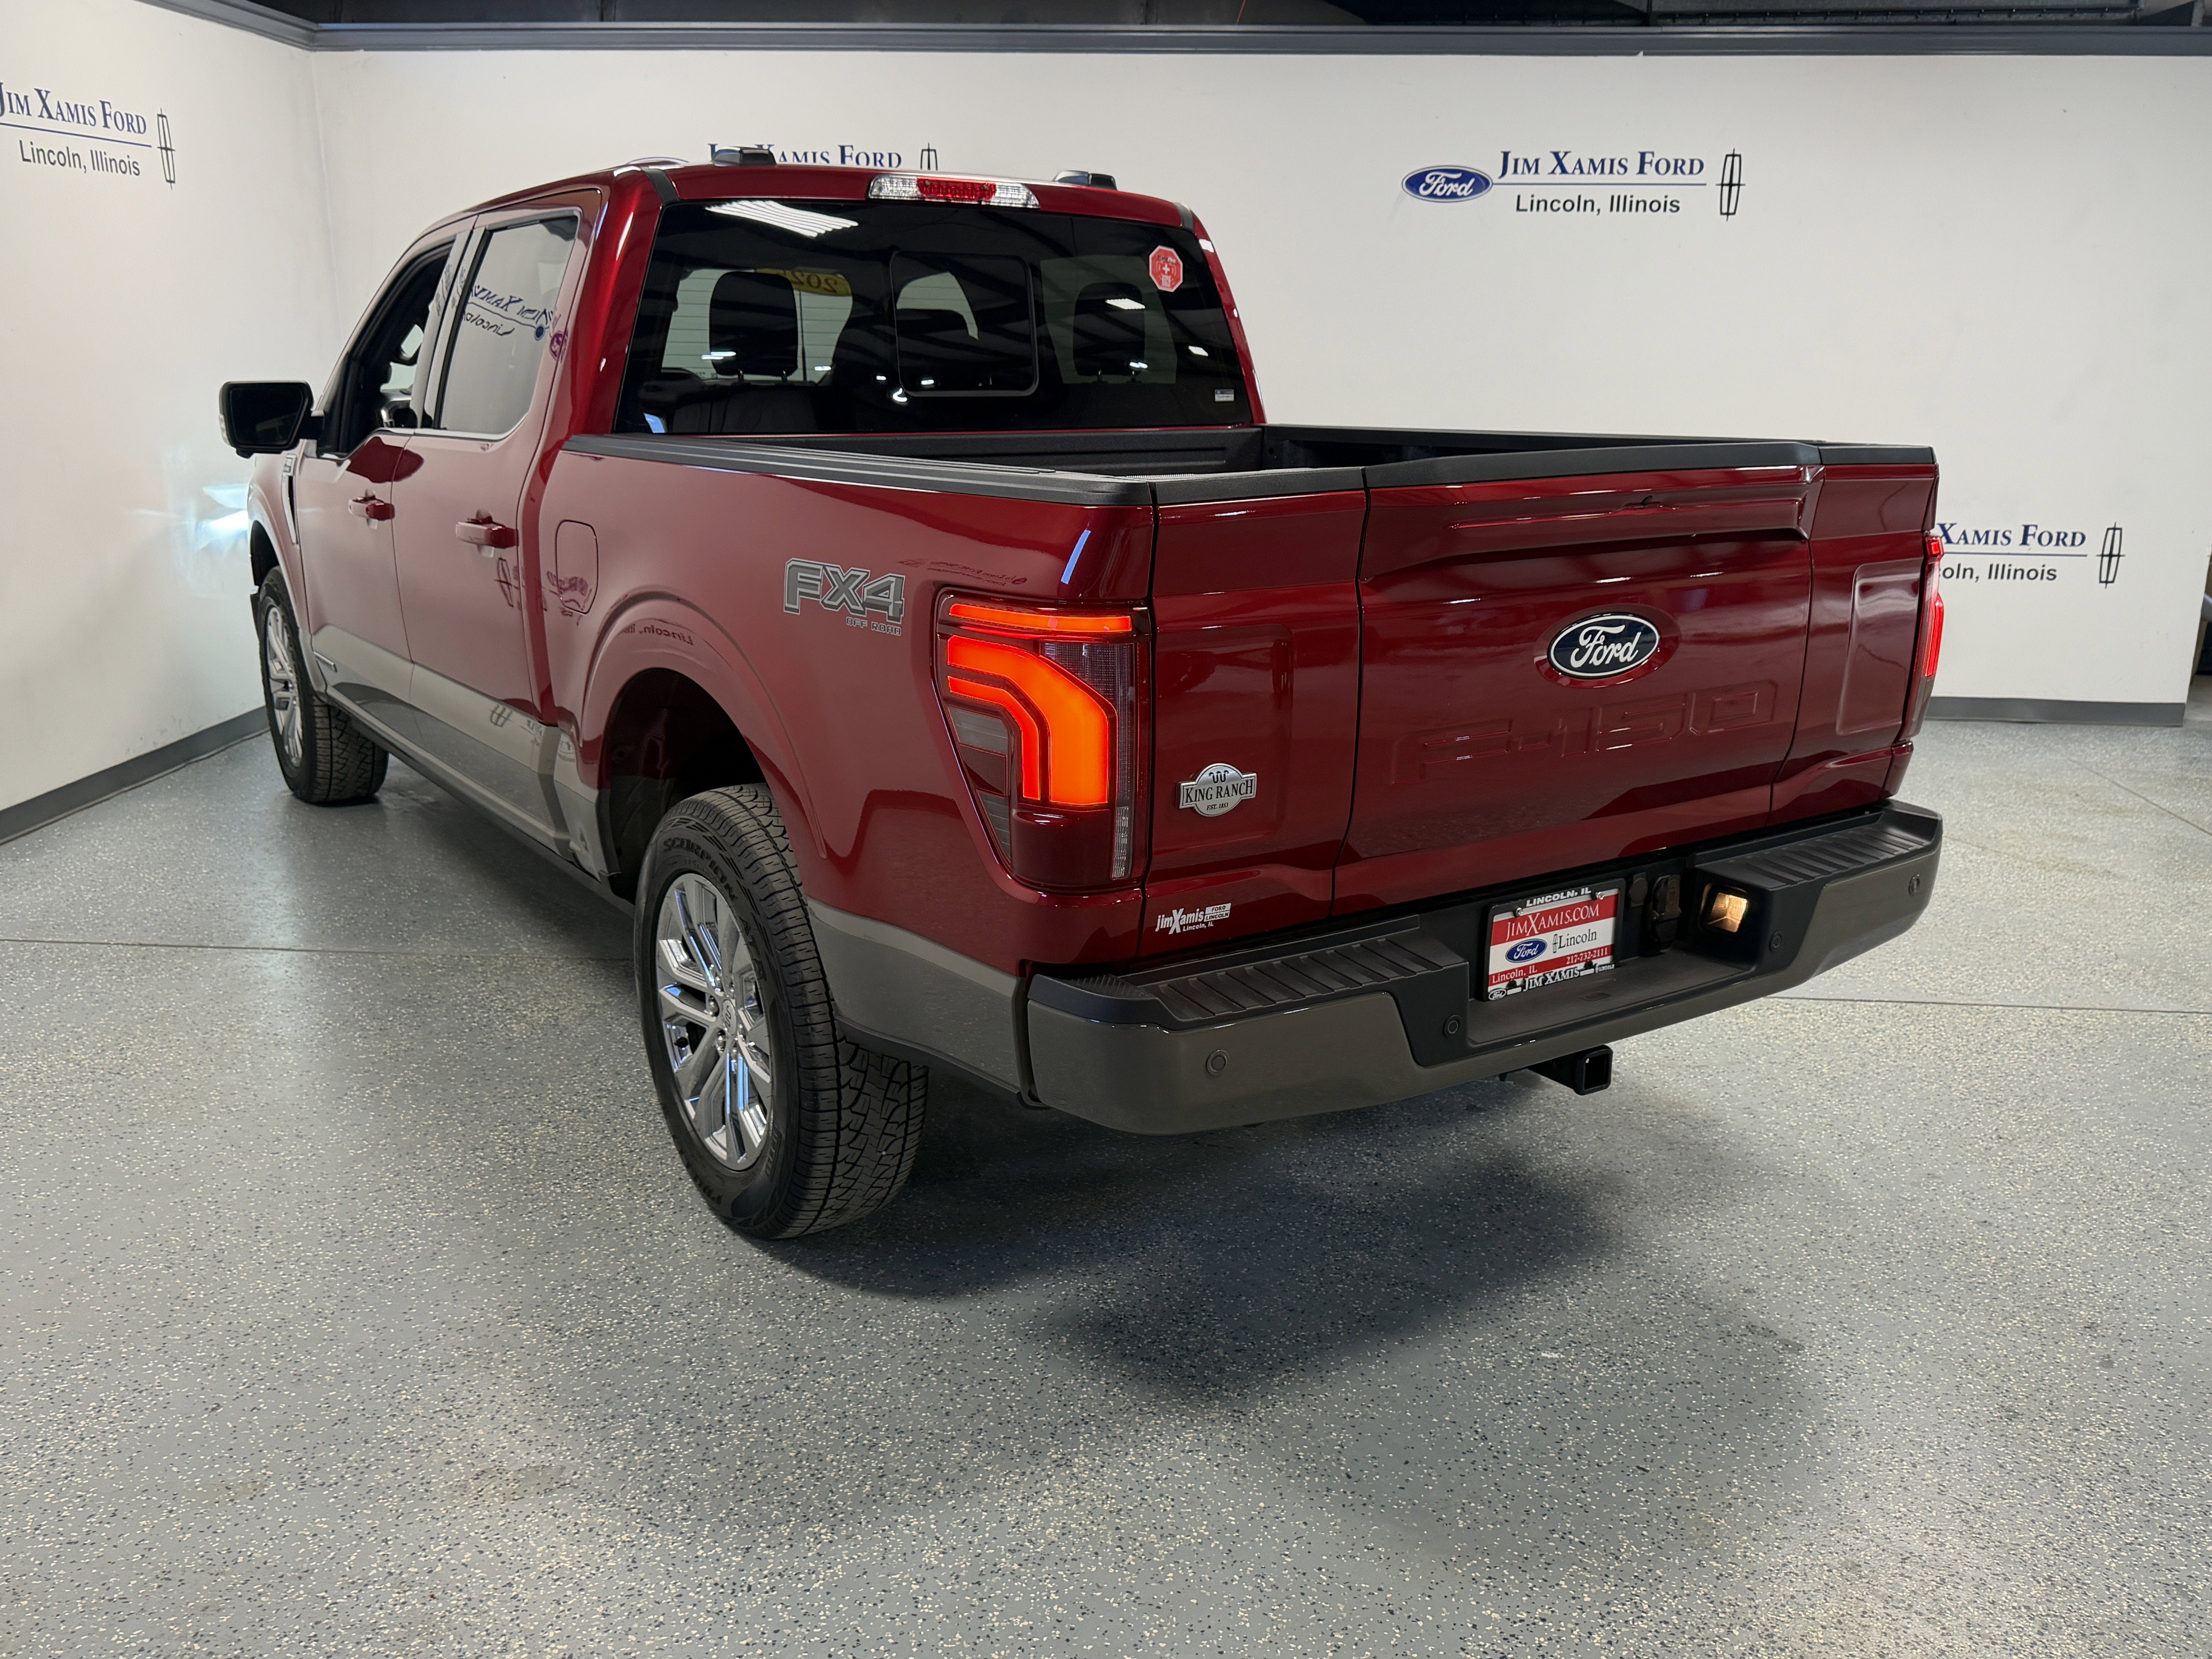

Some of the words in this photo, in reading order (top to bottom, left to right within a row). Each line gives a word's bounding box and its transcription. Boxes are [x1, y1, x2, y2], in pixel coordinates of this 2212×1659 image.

[34, 88, 96, 126] XAMIS
[99, 100, 146, 134] FORD
[19, 140, 87, 173] Lincoln,
[90, 149, 141, 176] Illinois
[837, 144, 902, 168] FORD
[1419, 171, 1473, 196] Ford
[1498, 151, 1540, 179] JIM
[1549, 151, 1628, 176] XAMIS
[1636, 151, 1705, 176] FORD
[1516, 194, 1601, 216] Lincoln,
[1609, 195, 1680, 213] Illinois
[1936, 522, 2012, 546] XAMIS
[2019, 524, 2086, 548] FORD
[1988, 563, 2057, 581] Illinois
[783, 558, 905, 624] FX4
[846, 617, 868, 629] OFF
[871, 621, 902, 636] ROAD
[1570, 624, 1640, 668] Ford
[1393, 679, 1778, 783] F-150
[1185, 787, 1212, 803] KING
[1216, 779, 1254, 799] RANCH
[1526, 890, 1577, 907] LINCOLN,
[1581, 887, 1591, 895] IL
[1183, 922, 1207, 931] Lincoln,
[1206, 912, 1229, 921] LINCOLN
[1506, 904, 1599, 942] JIMXAMIS.COM
[1514, 943, 1539, 959] Ford
[1558, 929, 1597, 950] Lincoln
[1566, 948, 1608, 965] 217-732-2111
[1523, 976, 1543, 991] JIM
[1544, 967, 1580, 986] XAMIS
[1529, 965, 1538, 974] IL
